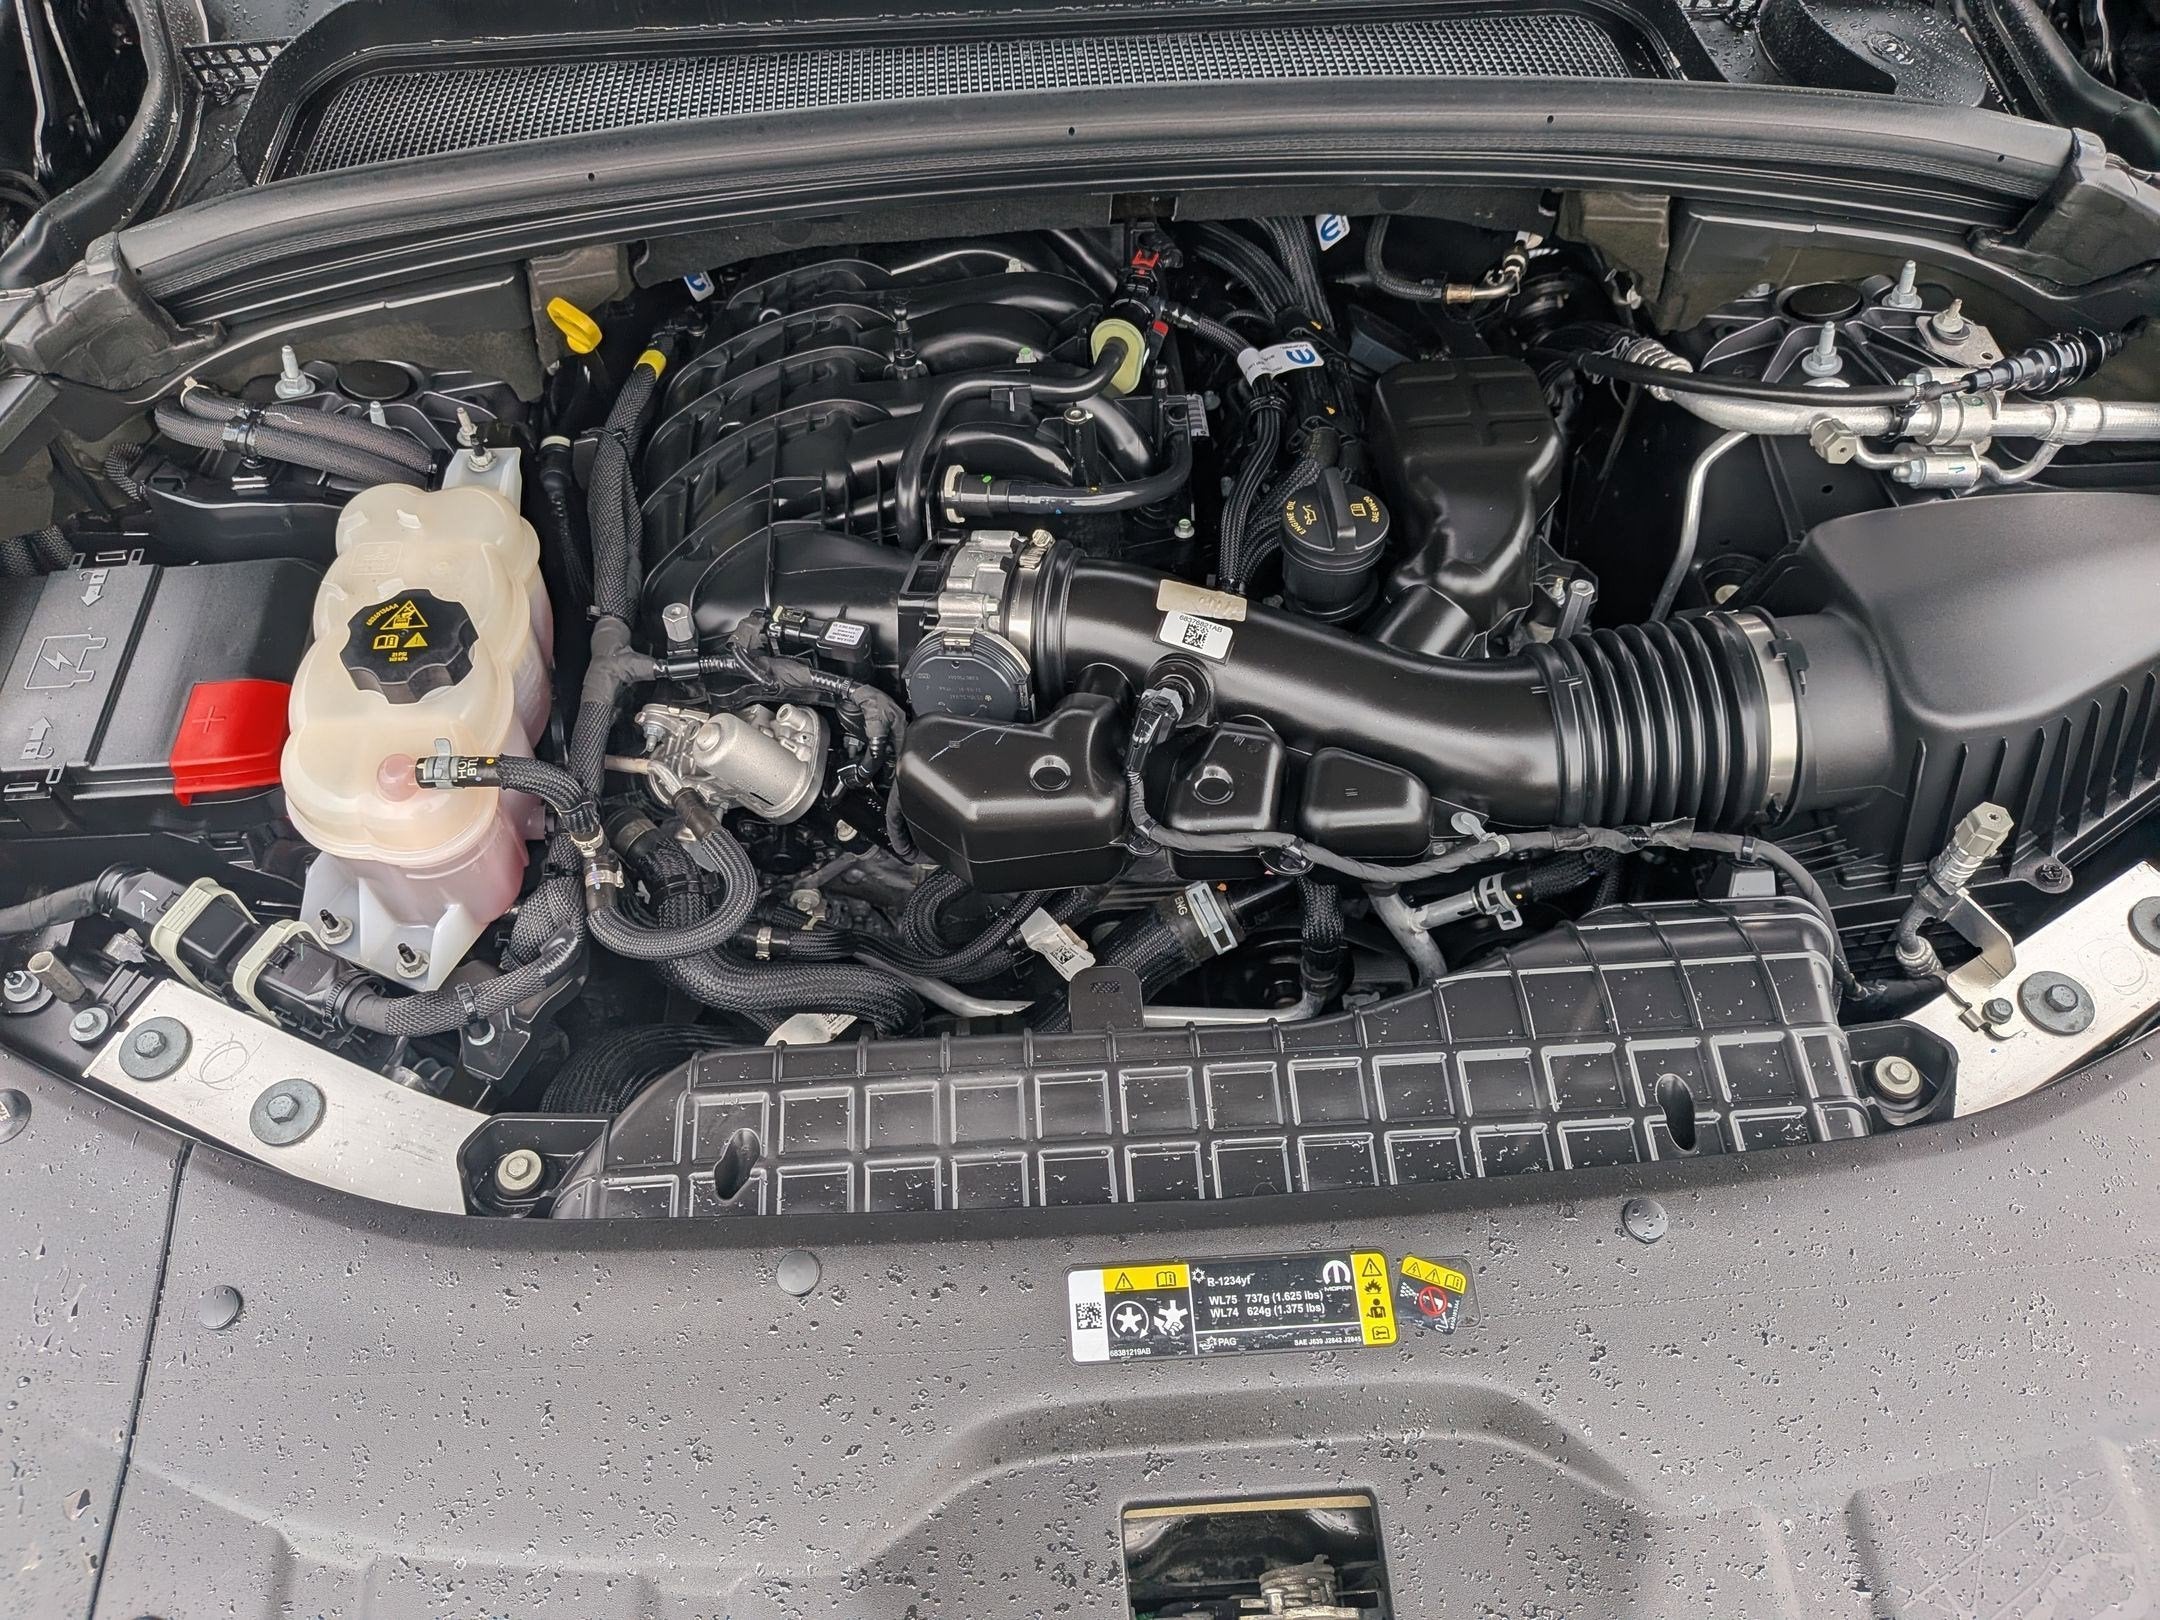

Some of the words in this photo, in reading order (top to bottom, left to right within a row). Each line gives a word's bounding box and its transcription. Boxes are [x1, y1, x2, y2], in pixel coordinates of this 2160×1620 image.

[1286, 500, 1296, 511] OIL
[1286, 512, 1307, 535] ENGINE
[1174, 895, 1188, 916] ENG
[1207, 1275, 1251, 1287] R-1234yf
[1209, 1294, 1238, 1306] WL75
[1245, 1293, 1270, 1305] 737g
[1272, 1290, 1302, 1303] (1.625
[1304, 1290, 1324, 1301] lbs)
[1210, 1307, 1239, 1319] WL74
[1247, 1306, 1272, 1317] 624g
[1274, 1304, 1304, 1316] (1.375
[1305, 1303, 1326, 1314] lbs)
[1218, 1337, 1238, 1346] PAG
